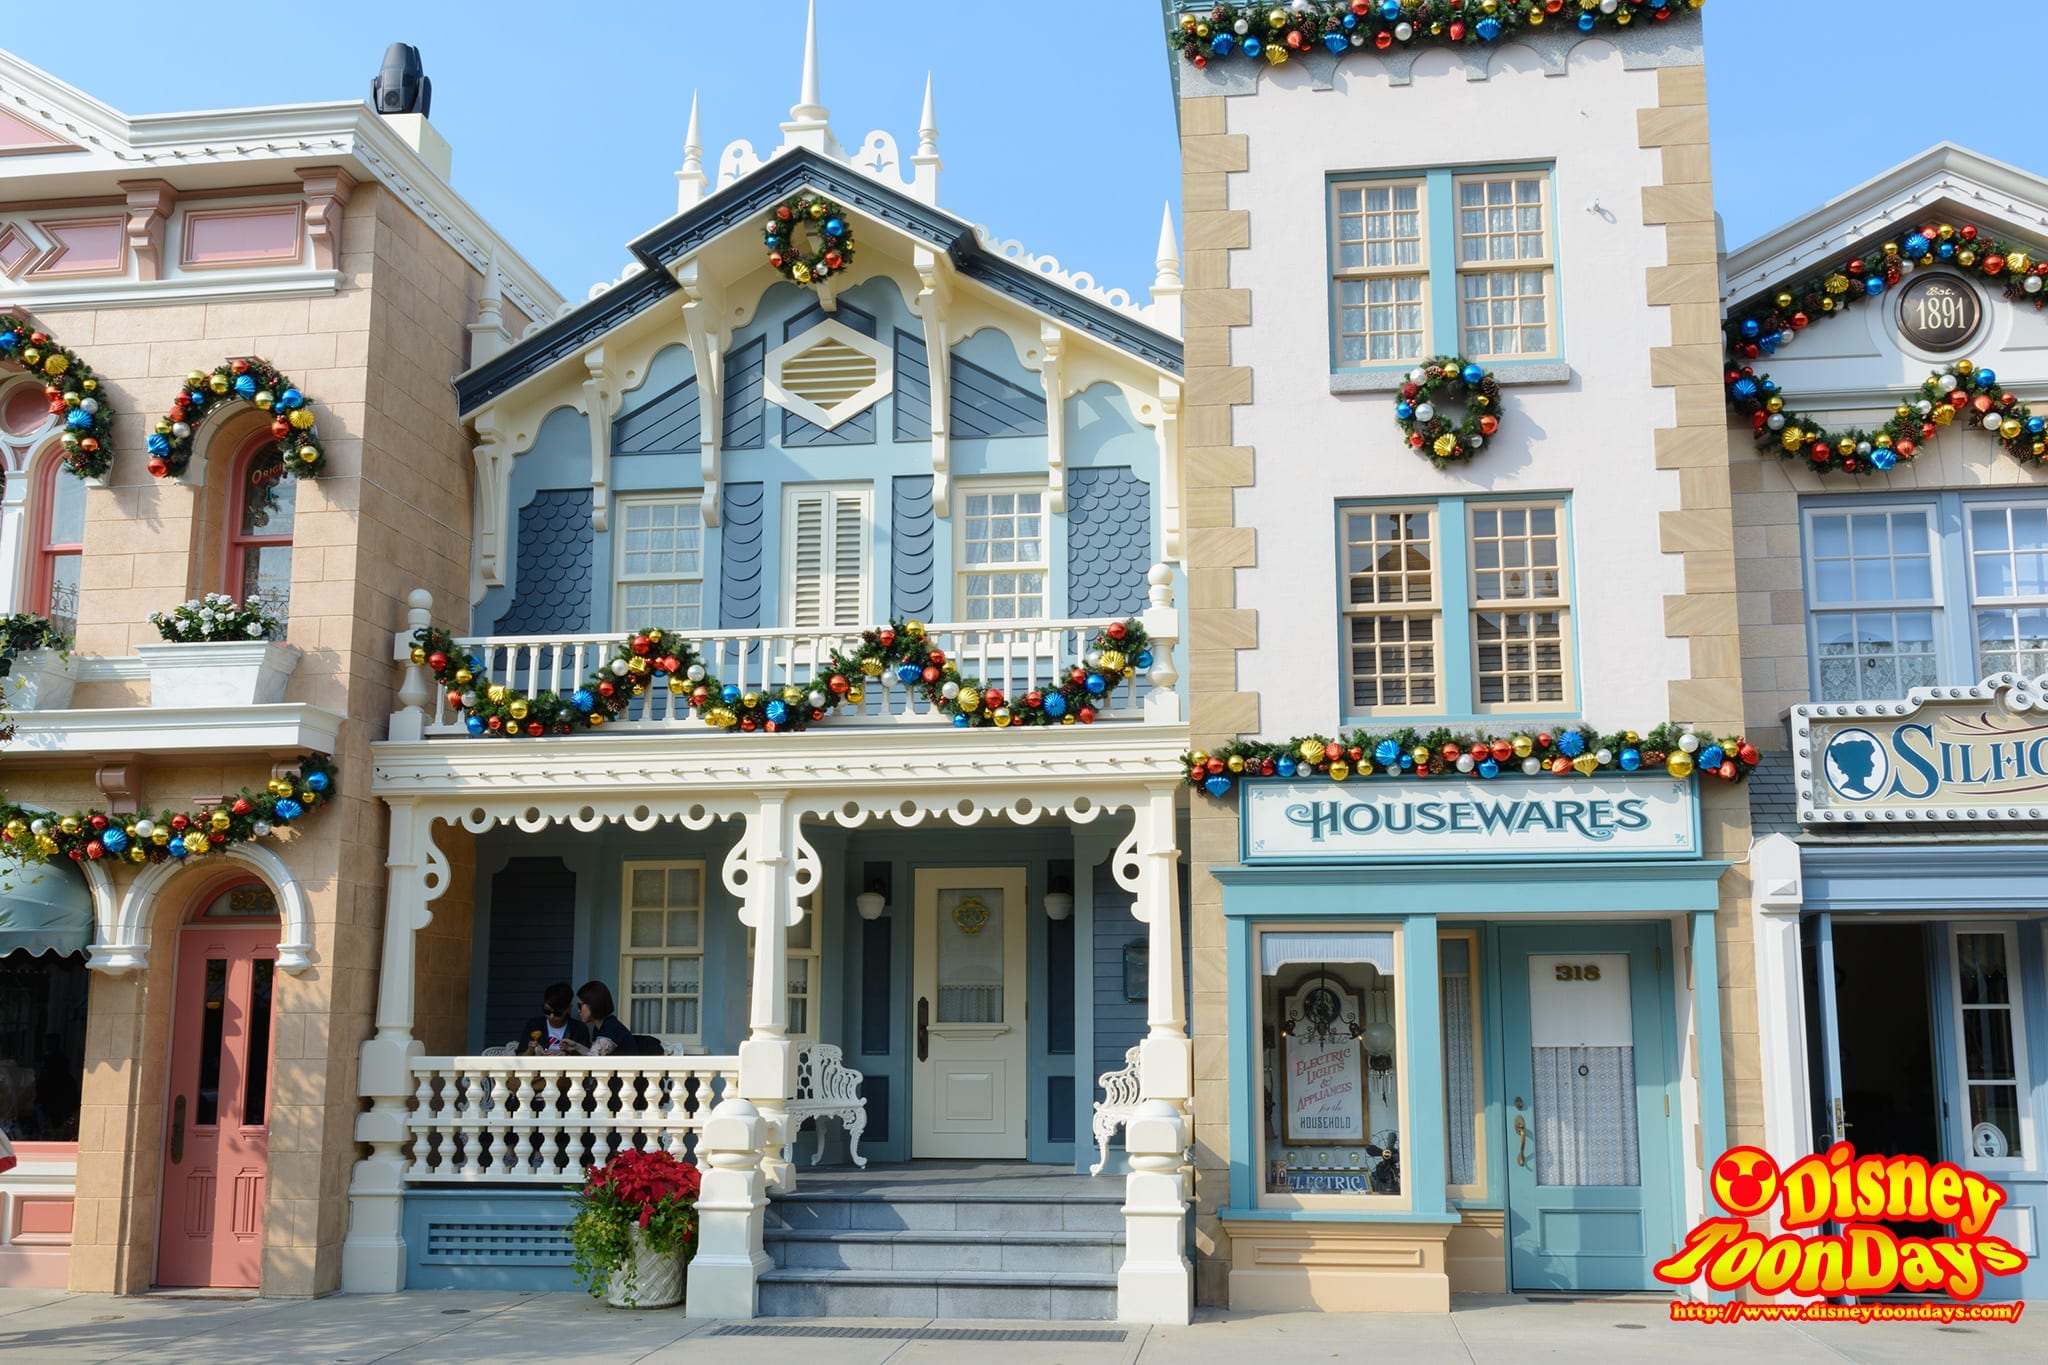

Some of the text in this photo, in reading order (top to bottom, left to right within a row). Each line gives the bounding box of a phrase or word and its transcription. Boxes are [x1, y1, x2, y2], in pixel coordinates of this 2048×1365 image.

[1916, 297, 1966, 330] 1891
[1285, 799, 1651, 842] HOUSEWARES
[1555, 964, 1601, 981] 318
[1296, 1048, 1352, 1077] ELECTRIC
[1306, 1062, 1345, 1085] LIGHTS
[1296, 1082, 1353, 1112] APPLIANCES
[1300, 1116, 1351, 1129] HOUSEHOLD
[1287, 1174, 1361, 1192] ELECTRIC
